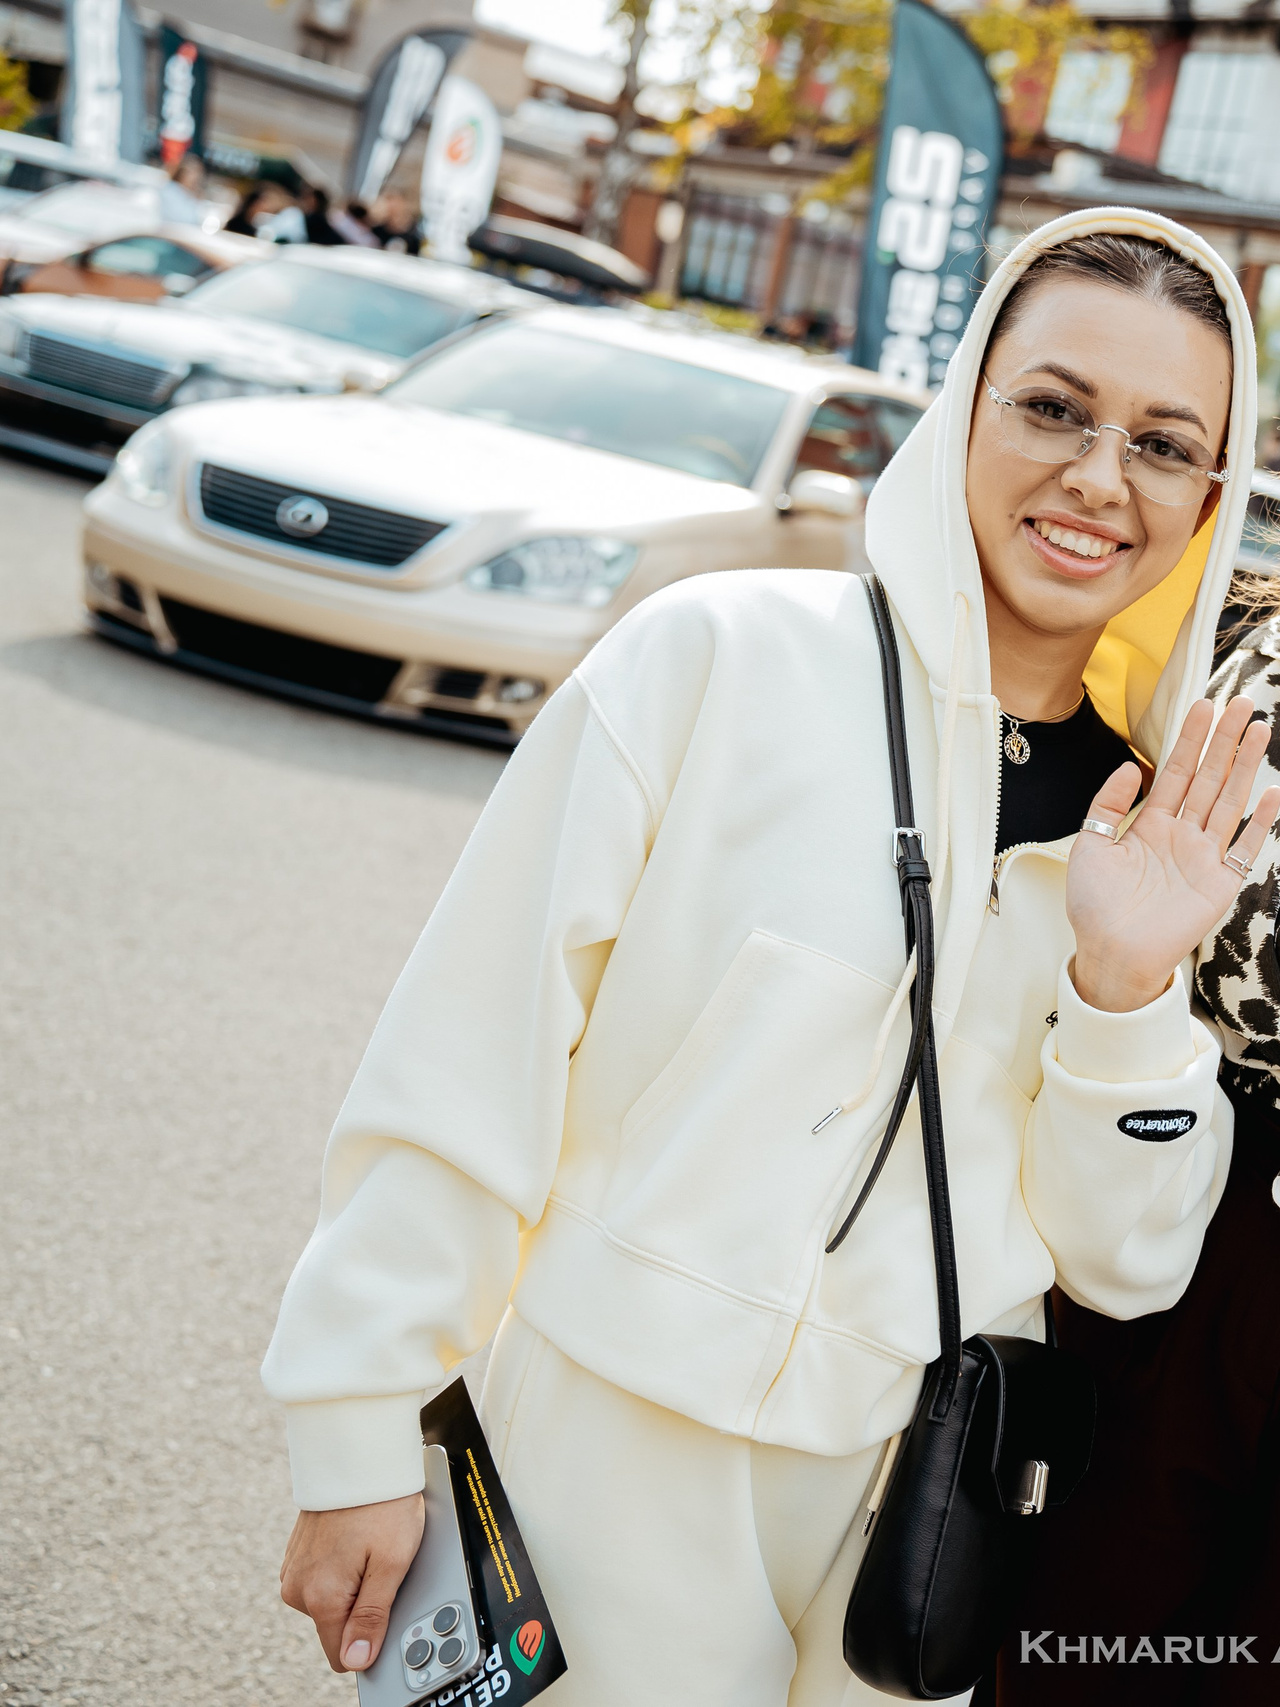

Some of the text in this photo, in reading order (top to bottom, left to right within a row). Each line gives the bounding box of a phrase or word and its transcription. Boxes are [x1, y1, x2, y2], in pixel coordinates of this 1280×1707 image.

[466, 1448, 521, 1597] Необходимо личное присутствие во время розыгрыша
[478, 1507, 487, 1521] руки
[484, 1525, 493, 1545] только
[501, 1576, 514, 1603] Подарок
